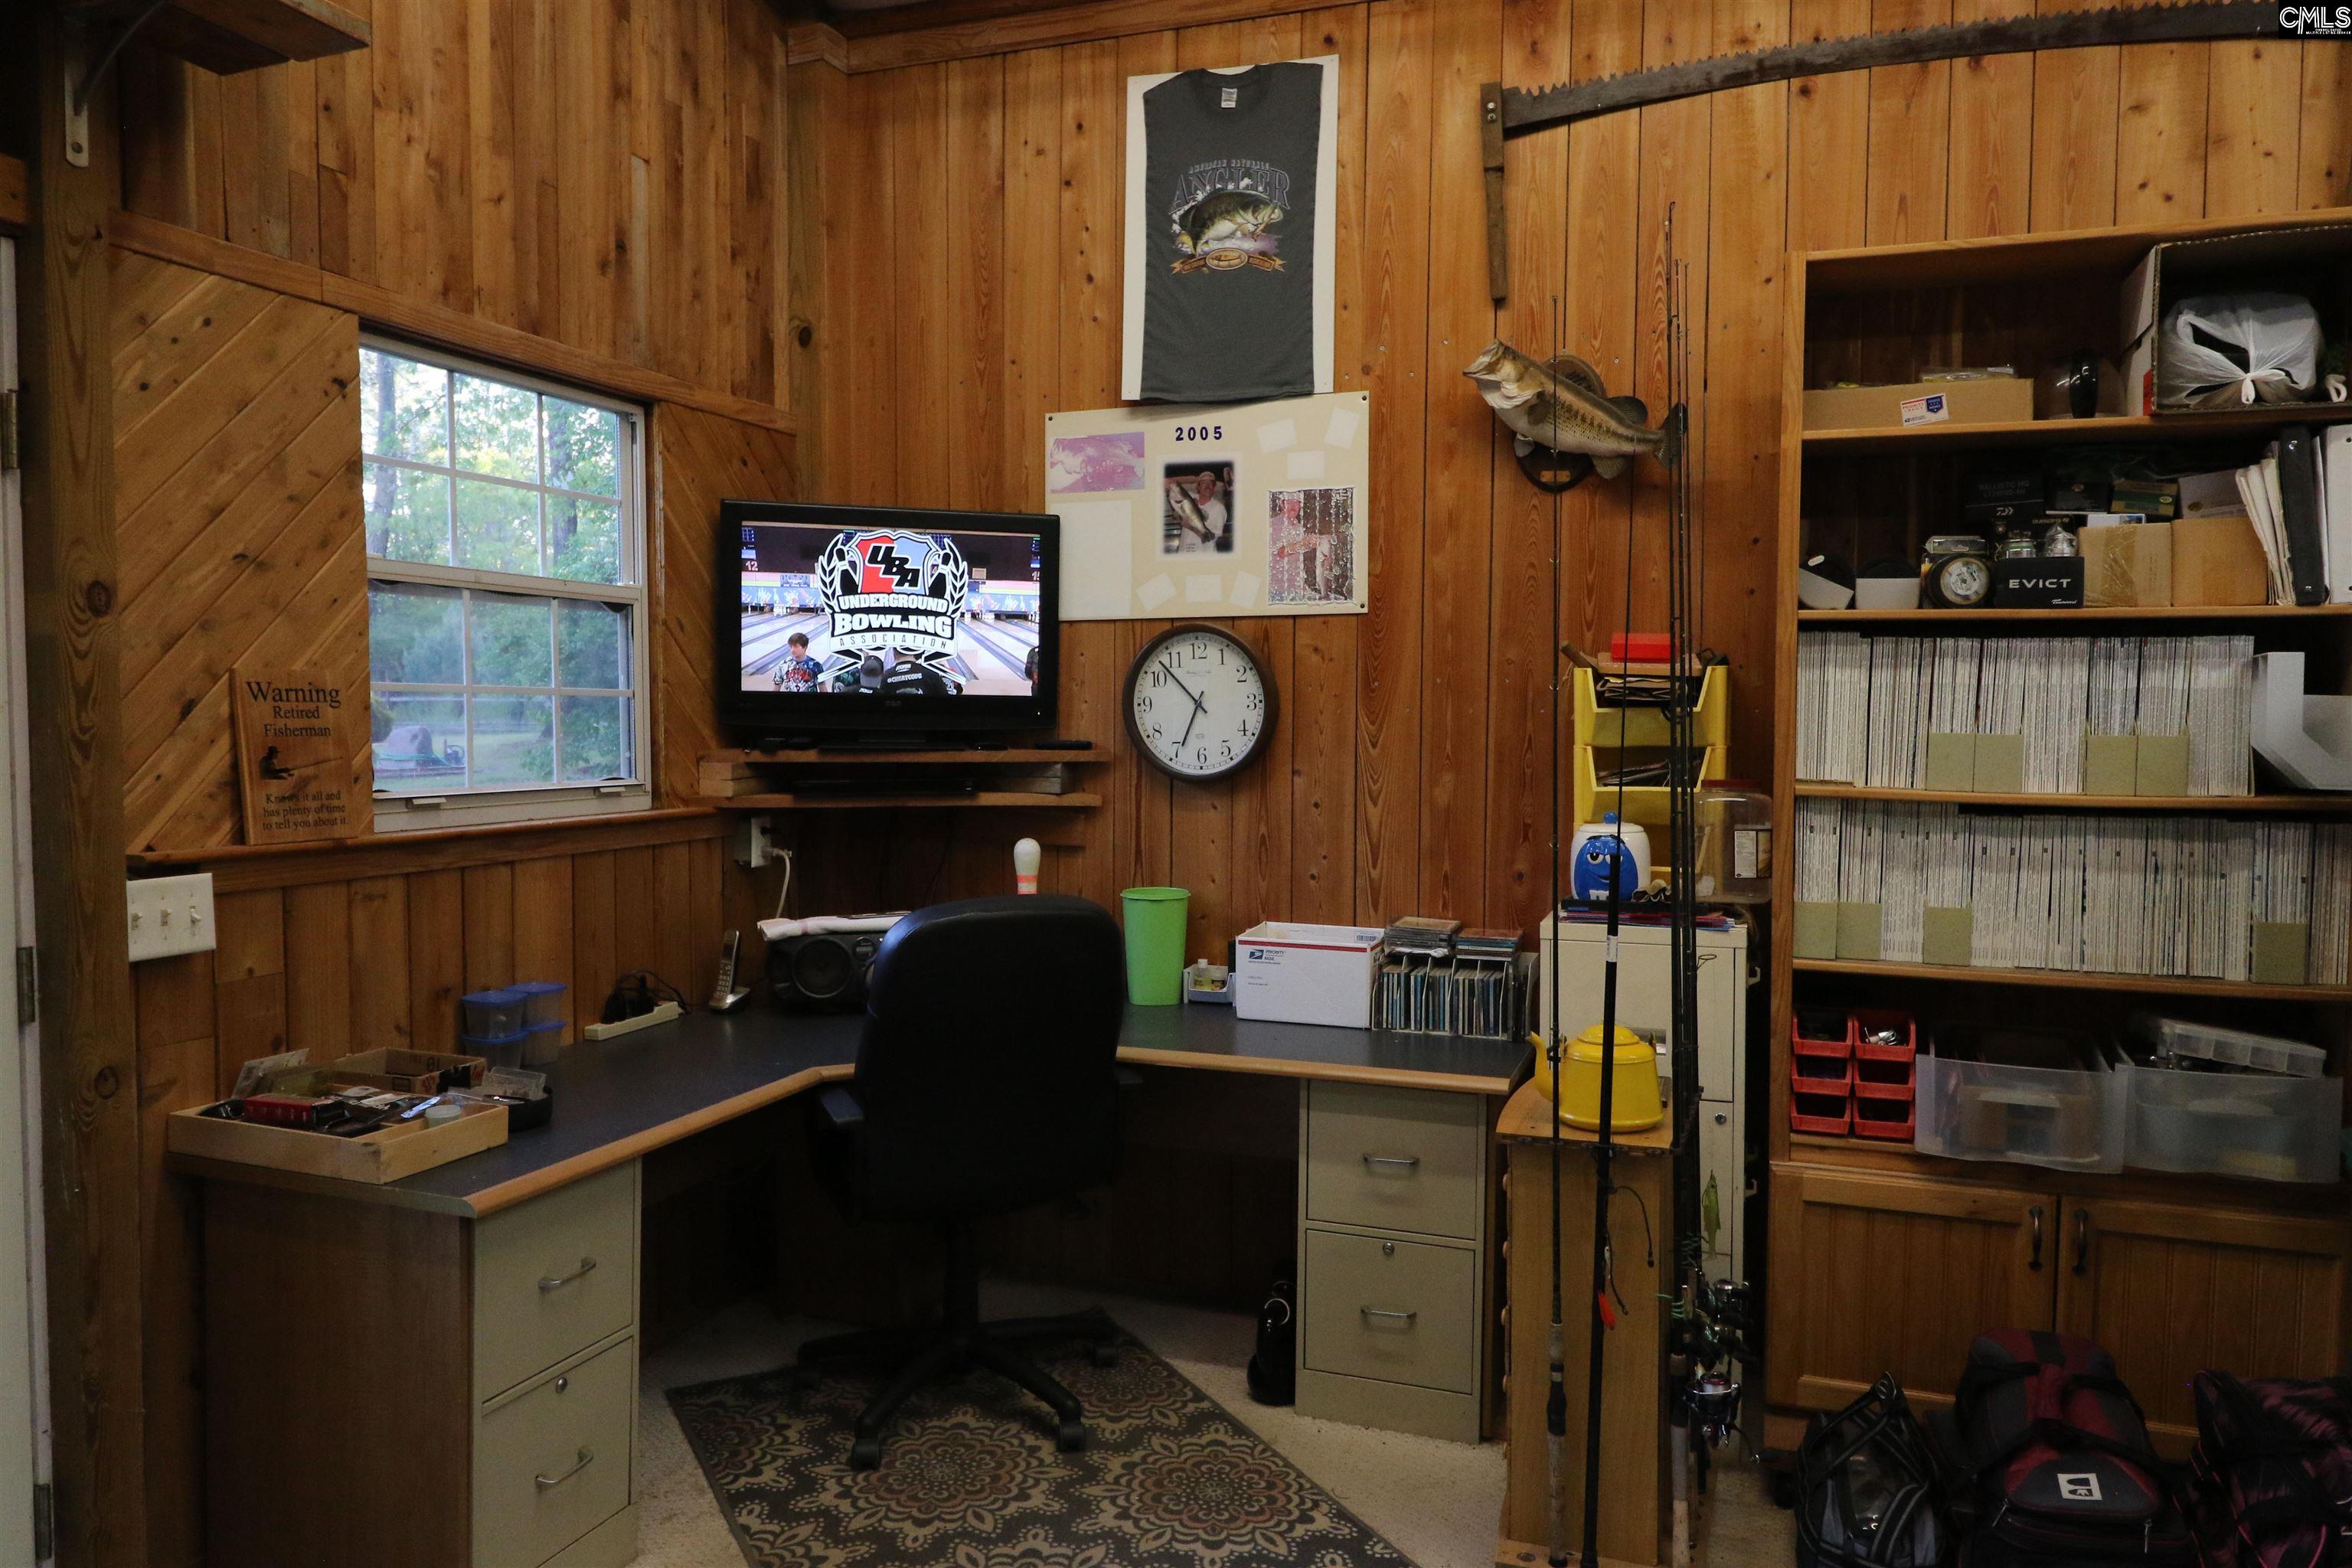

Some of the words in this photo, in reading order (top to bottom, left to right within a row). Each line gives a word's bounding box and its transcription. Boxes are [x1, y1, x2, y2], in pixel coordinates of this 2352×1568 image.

[1174, 426, 1223, 442] 2005
[745, 560, 759, 571] 12
[867, 544, 921, 588] UBA
[2008, 579, 2072, 589] EVICT
[838, 593, 949, 613] UNDERGROUND
[834, 612, 952, 639] BOWLING
[839, 634, 946, 649] ASSOCIATION
[1167, 651, 1183, 668] 11
[1189, 642, 1208, 660] 12
[1217, 648, 1225, 665] 1
[1150, 670, 1168, 688] 10
[1236, 665, 1247, 683] 2
[245, 681, 342, 708] Warning
[1246, 692, 1257, 710] 3
[273, 706, 321, 720] Retired
[1142, 696, 1152, 713] 9
[263, 724, 332, 737] Fisherman
[1152, 722, 1162, 740] 8
[1236, 719, 1249, 737] 4
[1171, 741, 1182, 758] 7
[1197, 746, 1207, 764] 6
[1220, 740, 1231, 757] 5
[266, 792, 300, 804] Knows
[311, 791, 323, 802] all
[324, 789, 341, 801] and
[263, 806, 280, 818] has
[283, 805, 312, 821] plenty
[314, 804, 325, 815] of
[325, 804, 346, 814] time
[263, 820, 273, 831] to
[274, 818, 291, 829] tell
[293, 819, 311, 831] you
[313, 816, 338, 828] about
